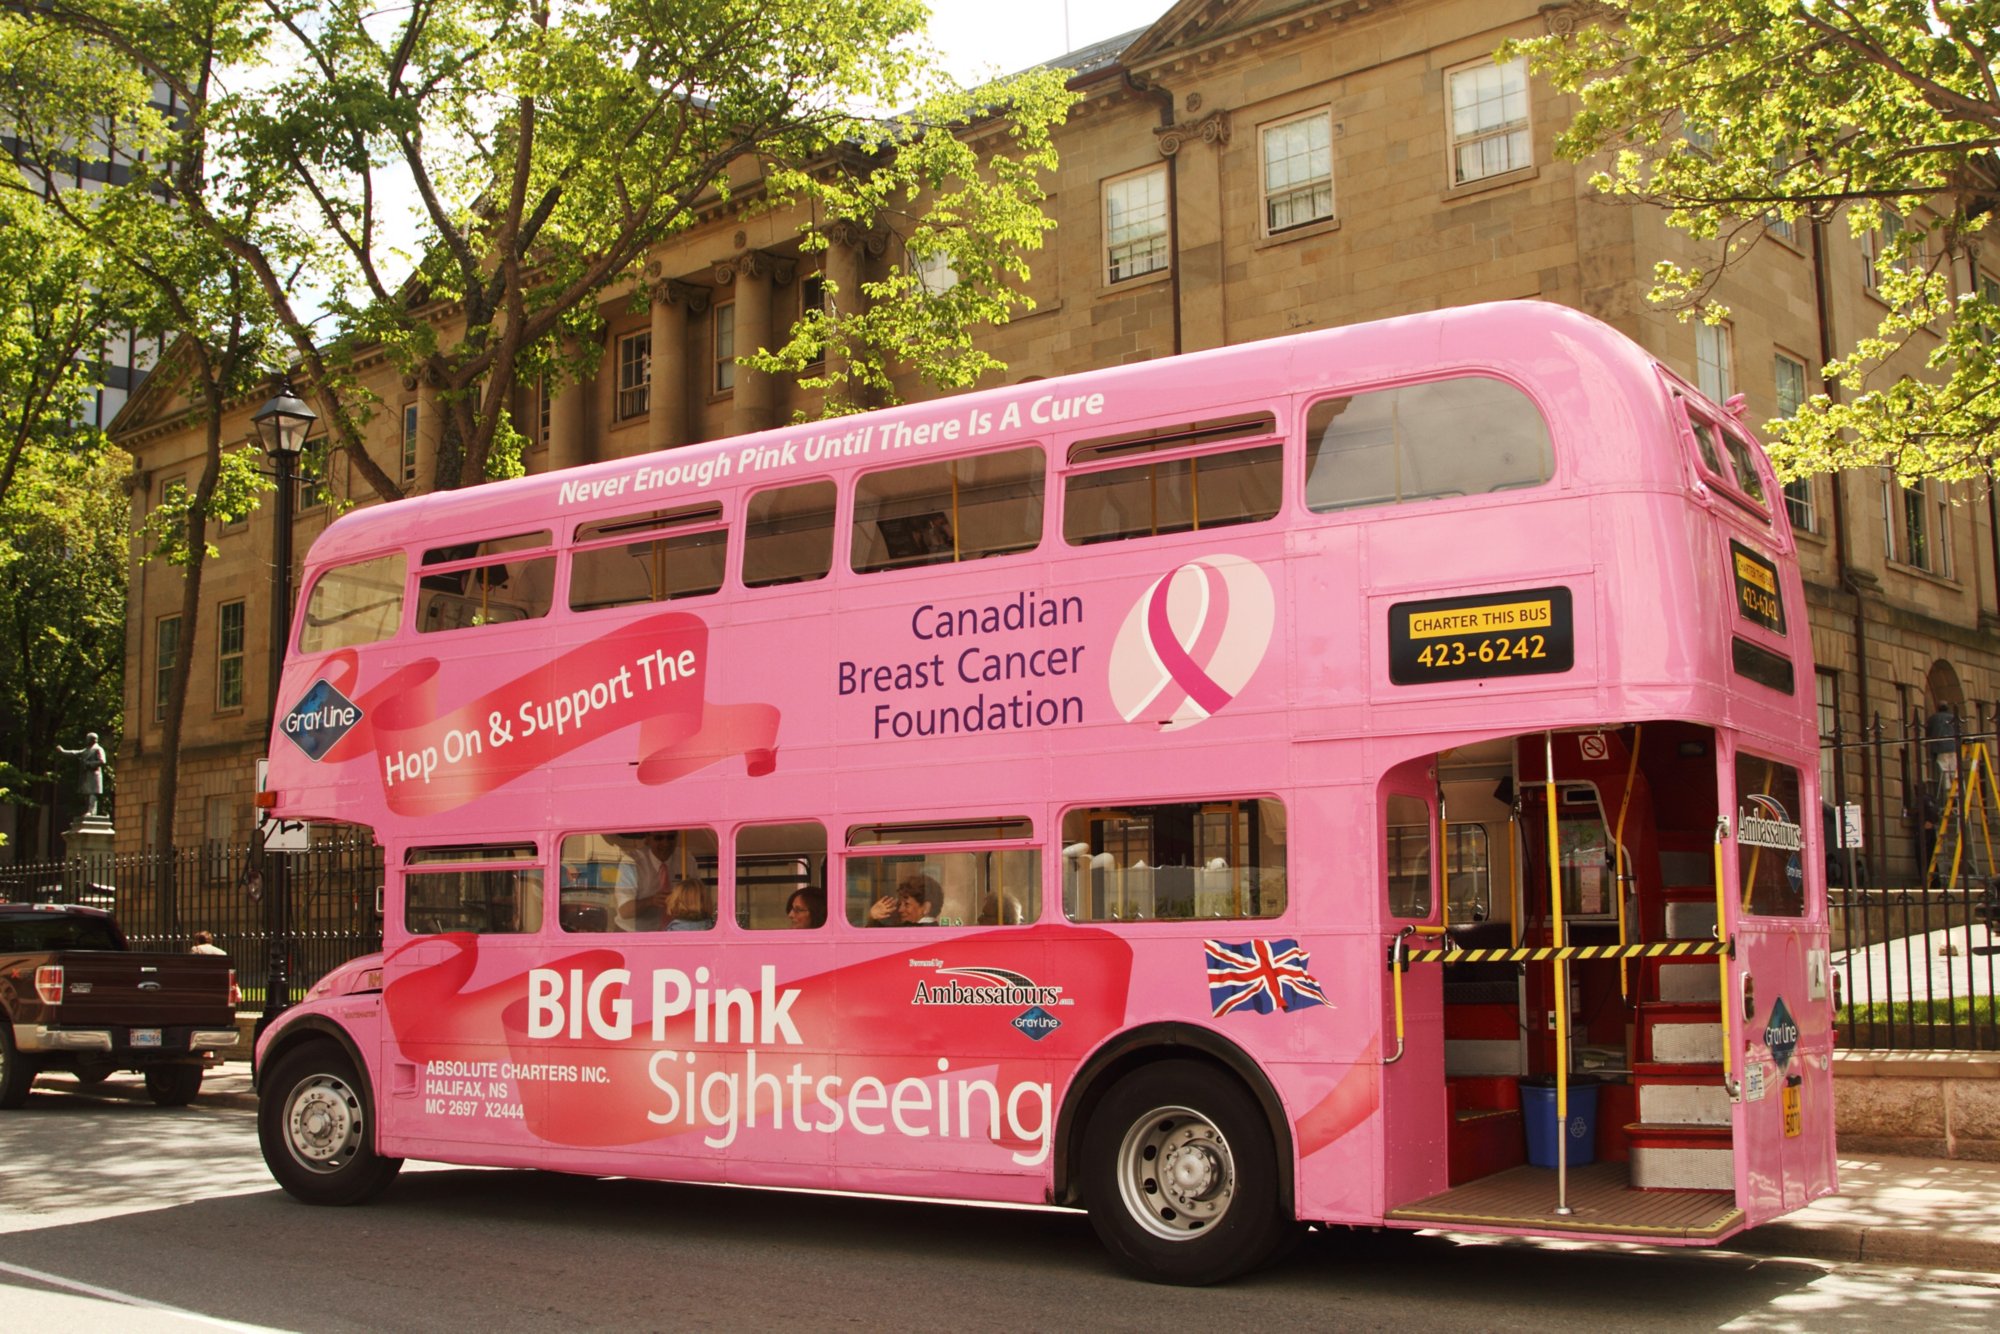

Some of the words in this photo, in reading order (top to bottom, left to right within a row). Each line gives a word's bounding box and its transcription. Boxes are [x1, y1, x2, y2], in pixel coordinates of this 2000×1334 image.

[558, 474, 630, 506] Never
[634, 452, 732, 487] Enough
[738, 440, 799, 474] Pink
[804, 426, 873, 461] Until
[879, 420, 960, 450] There
[968, 409, 992, 436] Is
[999, 402, 1022, 431] A
[1030, 392, 1105, 424] Cure
[911, 591, 1083, 640] Canadian
[1413, 614, 1478, 632] CHARTER
[1483, 610, 1515, 625] THIS
[1519, 607, 1548, 622] BUS
[1743, 586, 1778, 621] 423-6242
[838, 654, 945, 695] Breast
[957, 645, 1085, 683] Cancer
[1417, 634, 1546, 668] 423-6242
[385, 746, 438, 786] Hop
[443, 729, 483, 764] On
[488, 711, 514, 747] &
[519, 665, 634, 736] Support
[637, 648, 697, 691] The
[874, 690, 1083, 739] Foundation
[1738, 806, 1801, 851] Ambassatours
[527, 968, 633, 1041] BIG
[651, 965, 803, 1045] Pink
[912, 980, 1060, 1005] Ambassatours
[425, 1080, 485, 1099] HALIFAX,
[489, 1082, 508, 1098] NS
[426, 1060, 498, 1078] ABSOLUTE
[501, 1064, 578, 1082] CHARTERS
[581, 1066, 611, 1083] INC.
[425, 1099, 445, 1115] MC
[449, 1101, 479, 1117] 2697
[485, 1102, 525, 1119] X2444
[647, 1050, 1052, 1166] Sightseeing
